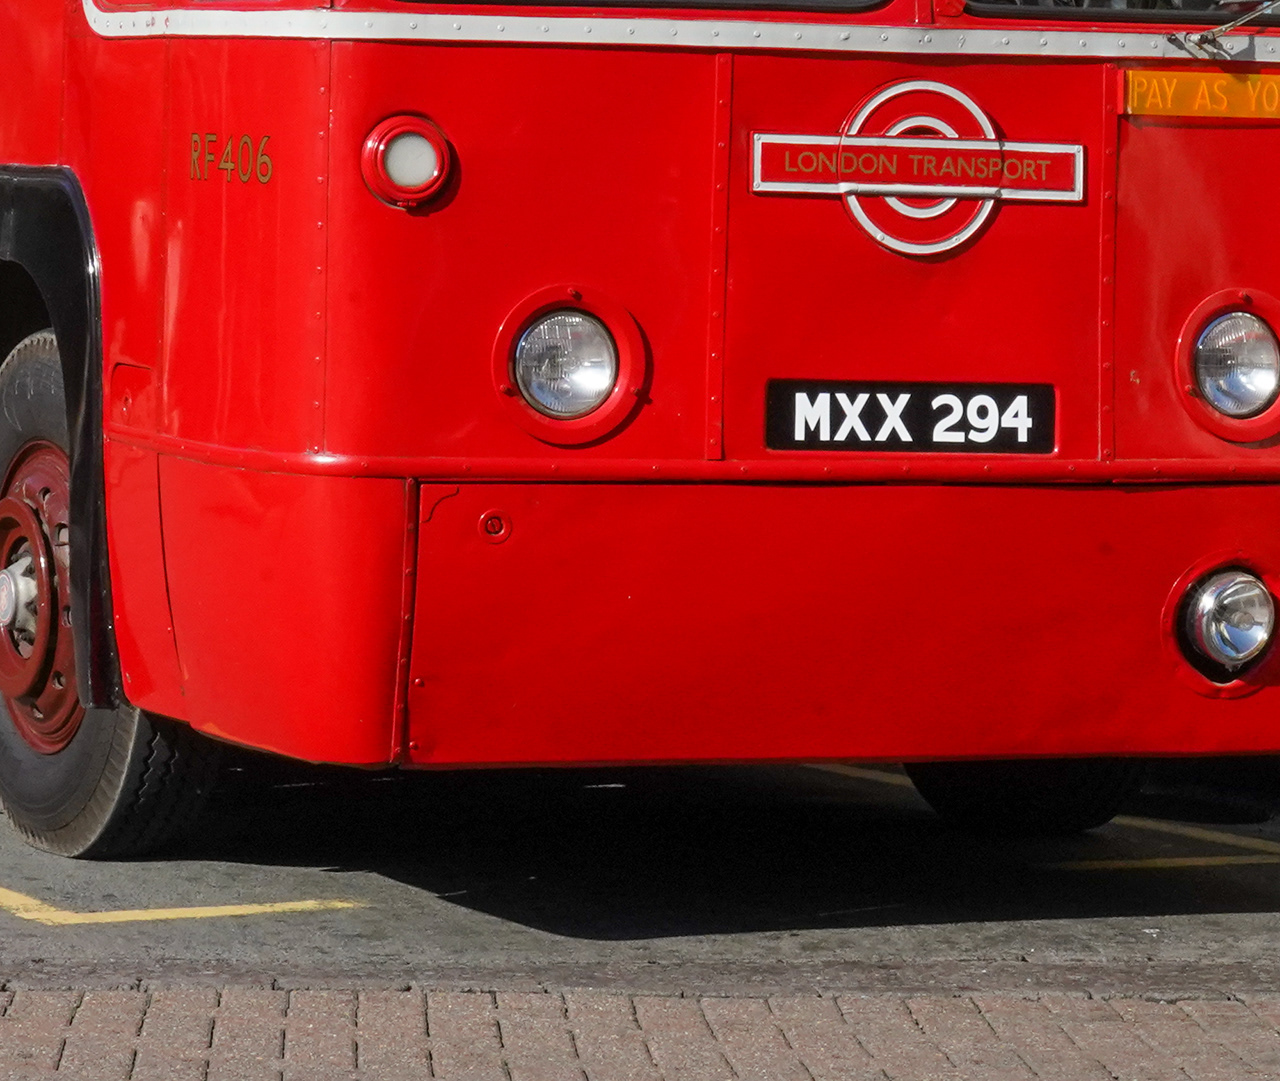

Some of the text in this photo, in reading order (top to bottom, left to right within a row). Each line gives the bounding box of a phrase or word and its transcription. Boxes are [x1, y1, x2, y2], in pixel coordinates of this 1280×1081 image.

[1132, 77, 1178, 109] PAY
[1194, 79, 1228, 111] AS
[190, 132, 272, 185] RF406
[785, 151, 1051, 181] LONDON TRANSPORT
[794, 392, 1033, 443] MXX 294
